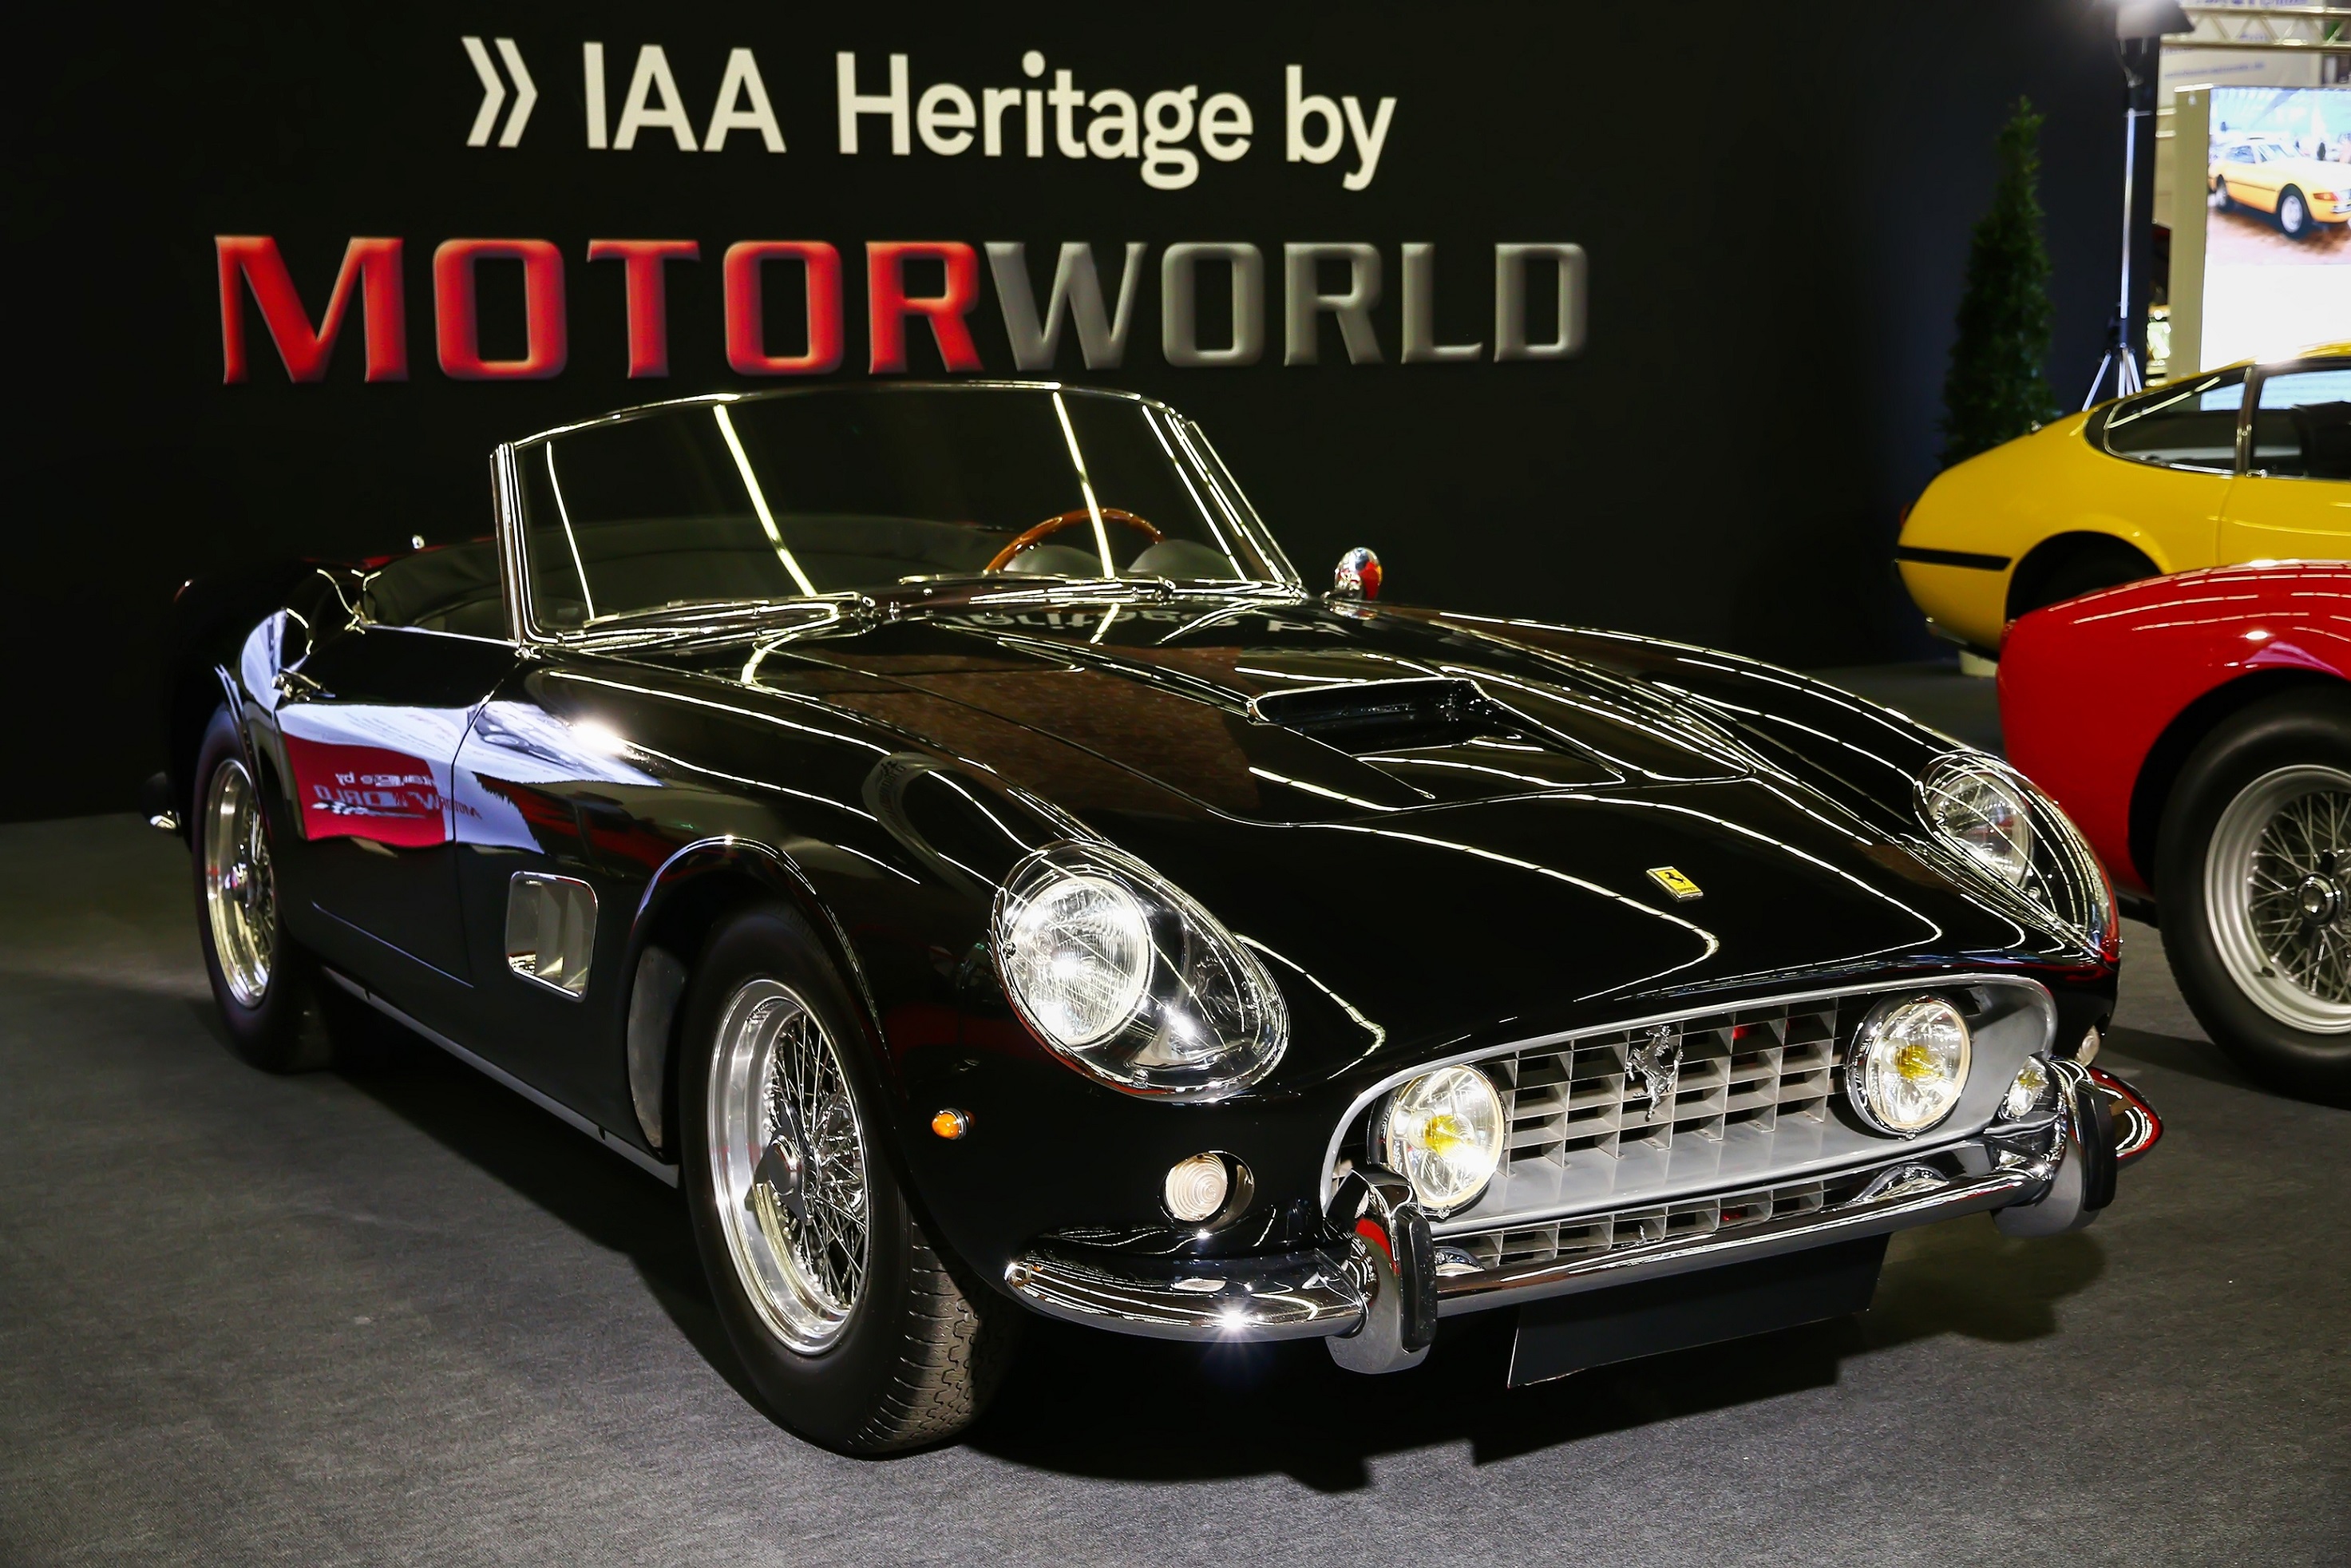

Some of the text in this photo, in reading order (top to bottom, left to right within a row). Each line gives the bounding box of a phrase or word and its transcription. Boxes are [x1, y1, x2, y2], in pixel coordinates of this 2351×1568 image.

[583, 42, 1397, 191] IAA Heritage by
[213, 235, 1589, 383] MOTORWORLD
